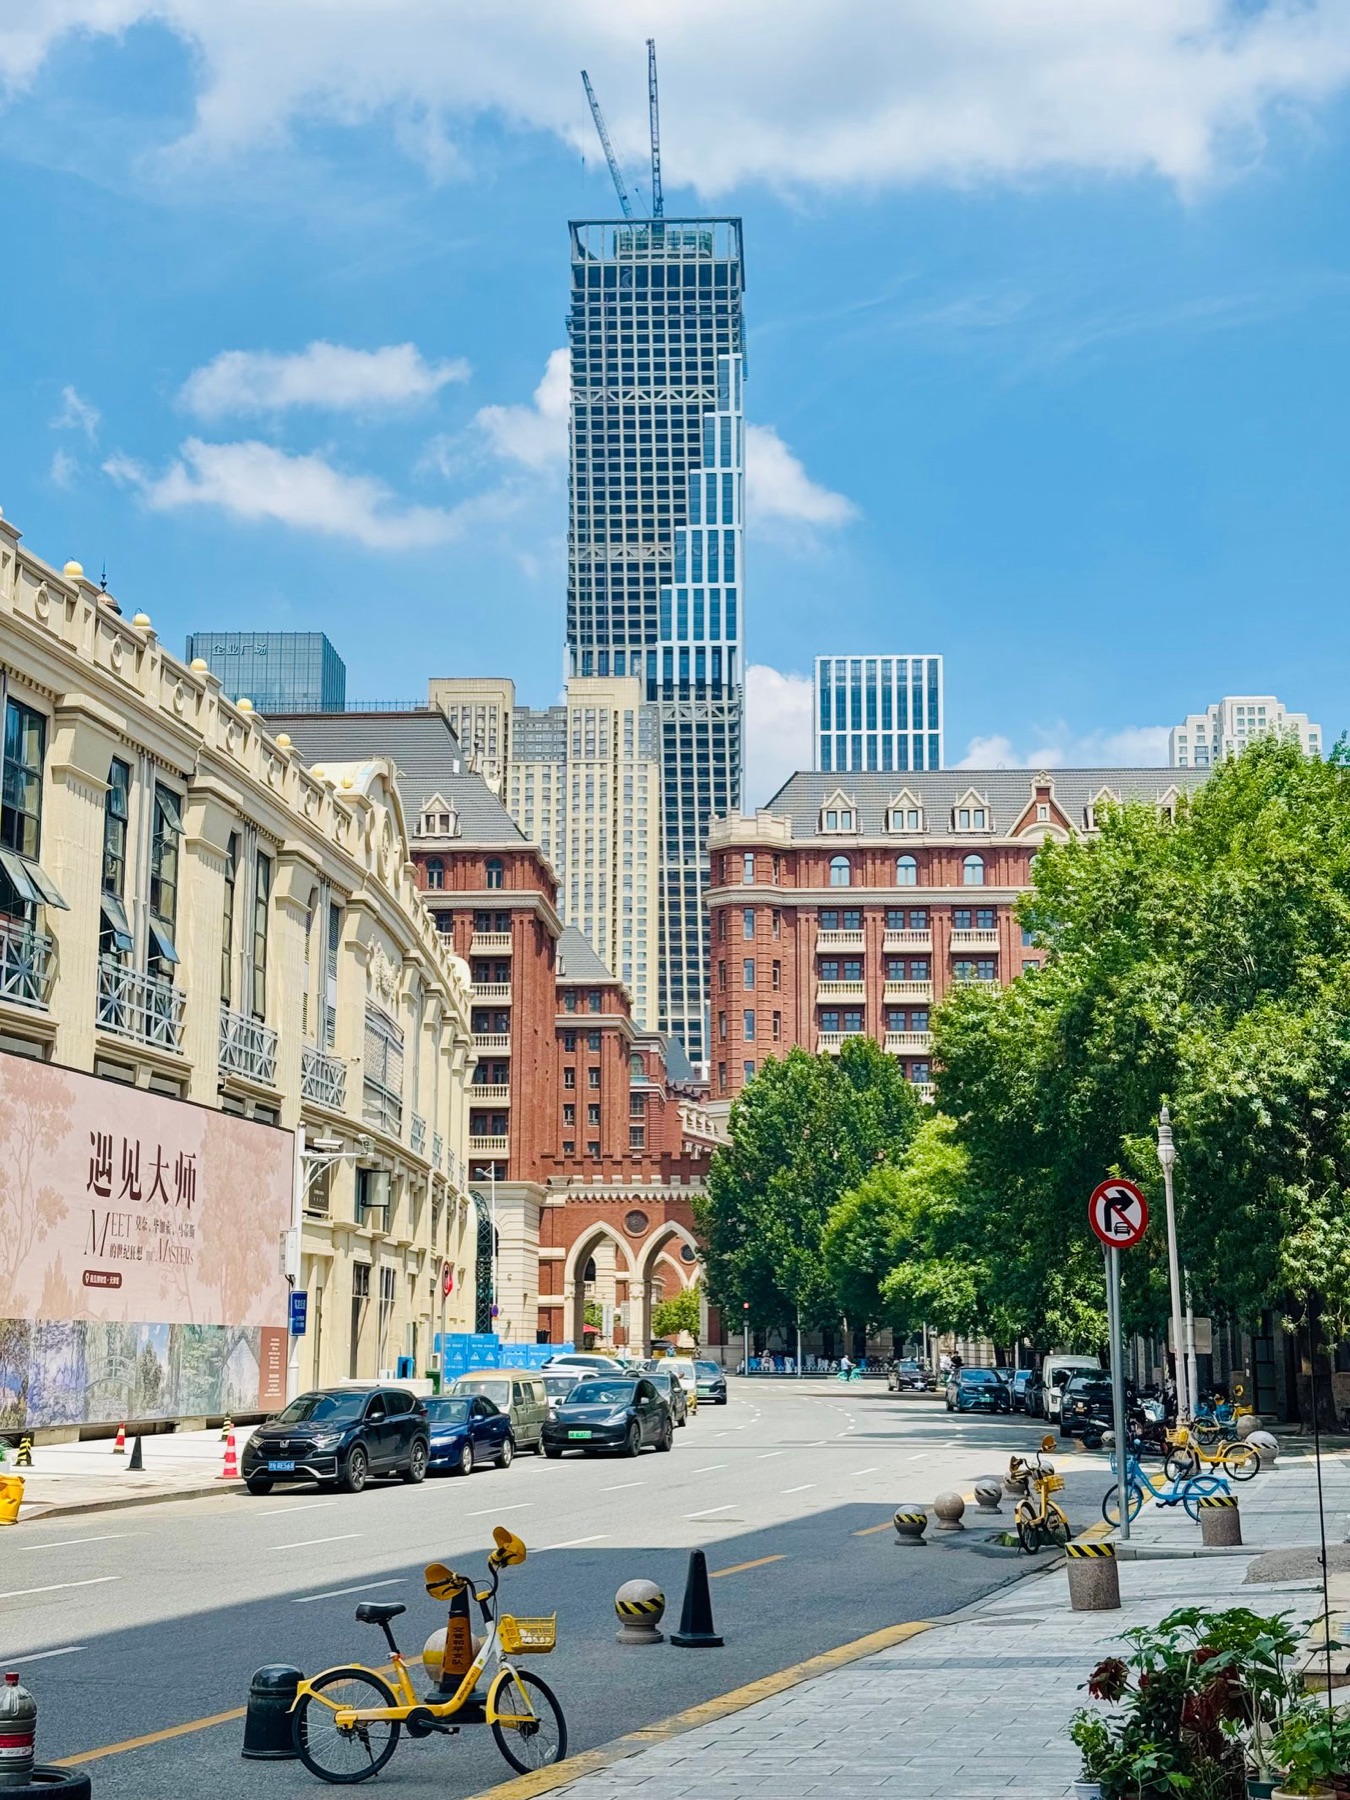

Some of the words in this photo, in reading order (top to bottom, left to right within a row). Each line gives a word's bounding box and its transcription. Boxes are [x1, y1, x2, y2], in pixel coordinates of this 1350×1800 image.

[212, 643, 267, 656] 企业广场
[86, 1130, 197, 1210] 遇见大师
[83, 1209, 133, 1257] MEET
